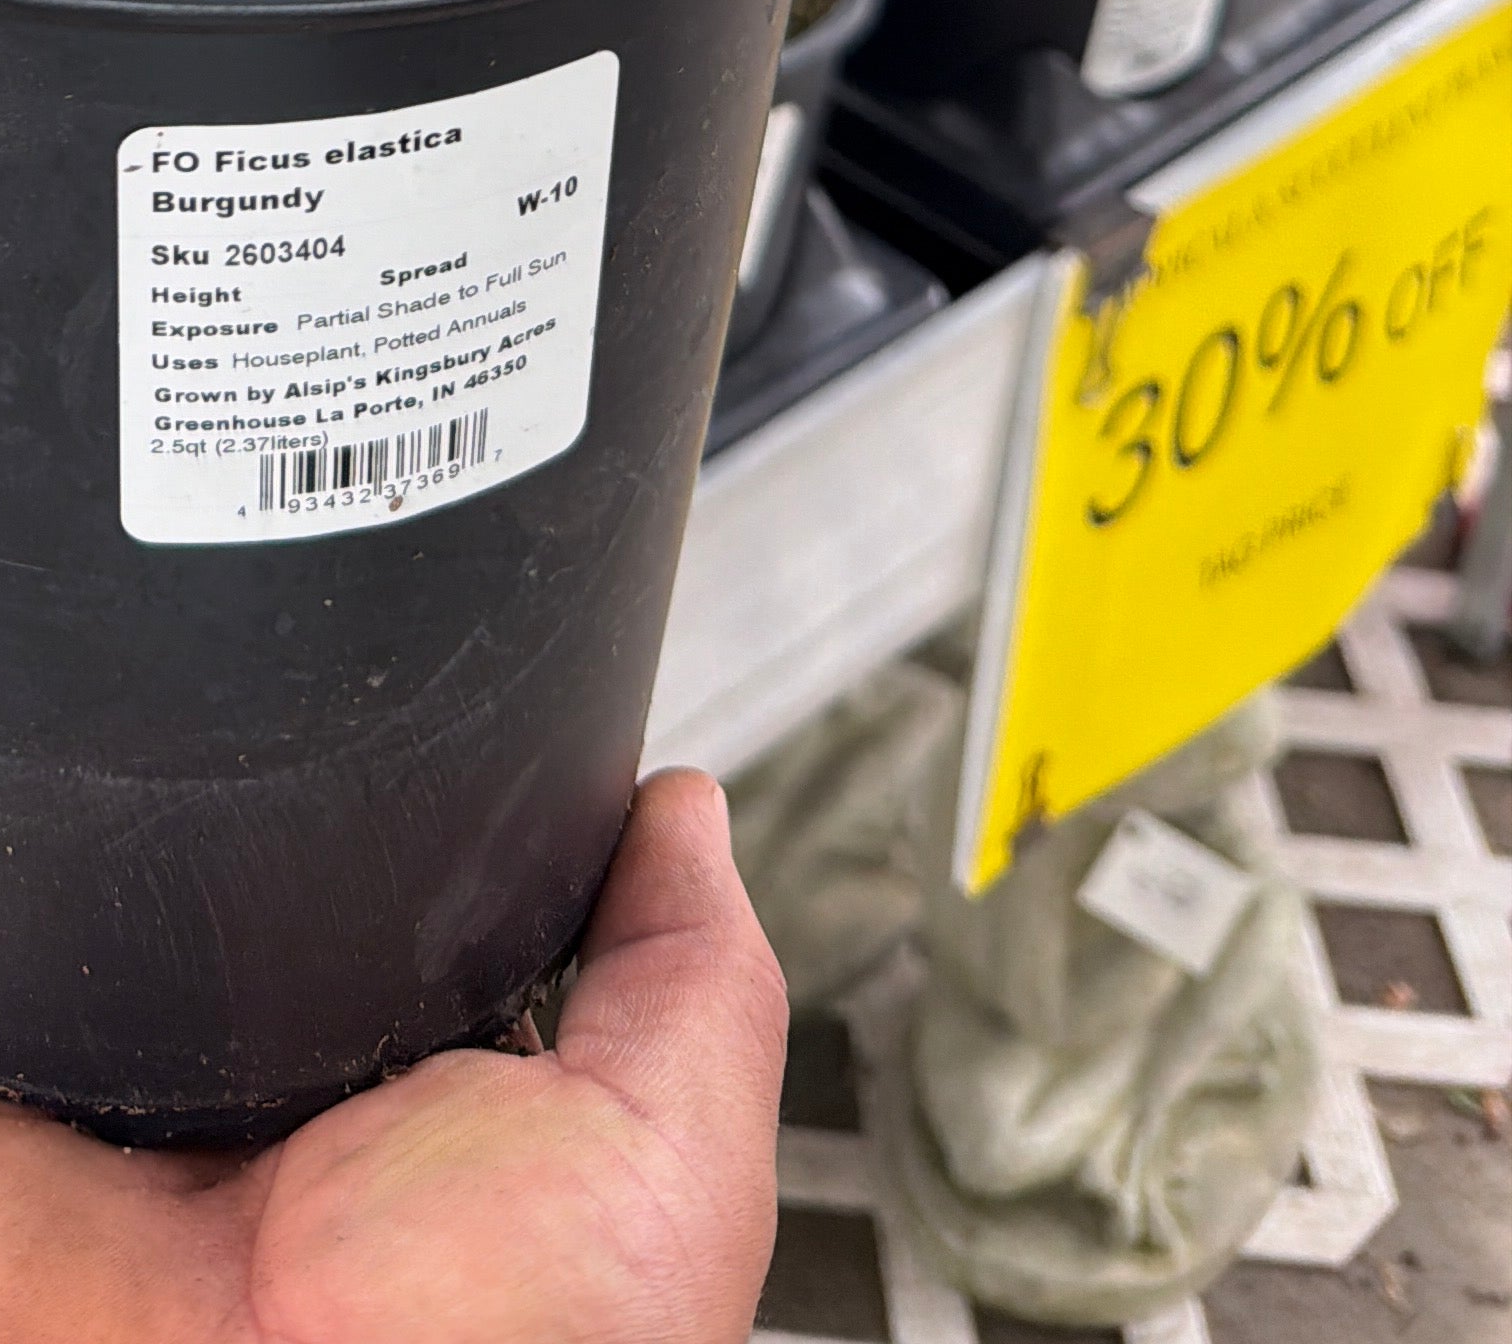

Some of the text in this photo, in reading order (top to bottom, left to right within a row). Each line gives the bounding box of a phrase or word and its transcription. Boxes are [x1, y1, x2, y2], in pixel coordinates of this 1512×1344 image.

[152, 127, 462, 173] FO Ficus elastica
[152, 187, 326, 218] Burgundy
[517, 175, 578, 216] W-10
[151, 234, 346, 266] Sku 2603404
[151, 252, 468, 308] Height Spread
[151, 251, 567, 341] Exposure Partial Shade to Full Sun
[152, 299, 527, 370] Uses Houseplant, Potted Annuals
[154, 317, 556, 404] Grown by Alsip's Kingsbury Acres
[154, 354, 528, 432] Greenhouse La Porte, IN 46350
[1085, 207, 1489, 526] 30% OFF
[150, 430, 329, 457] 2.5qt (2.37liters)
[288, 488, 372, 514] 93432
[384, 463, 460, 500] 37369
